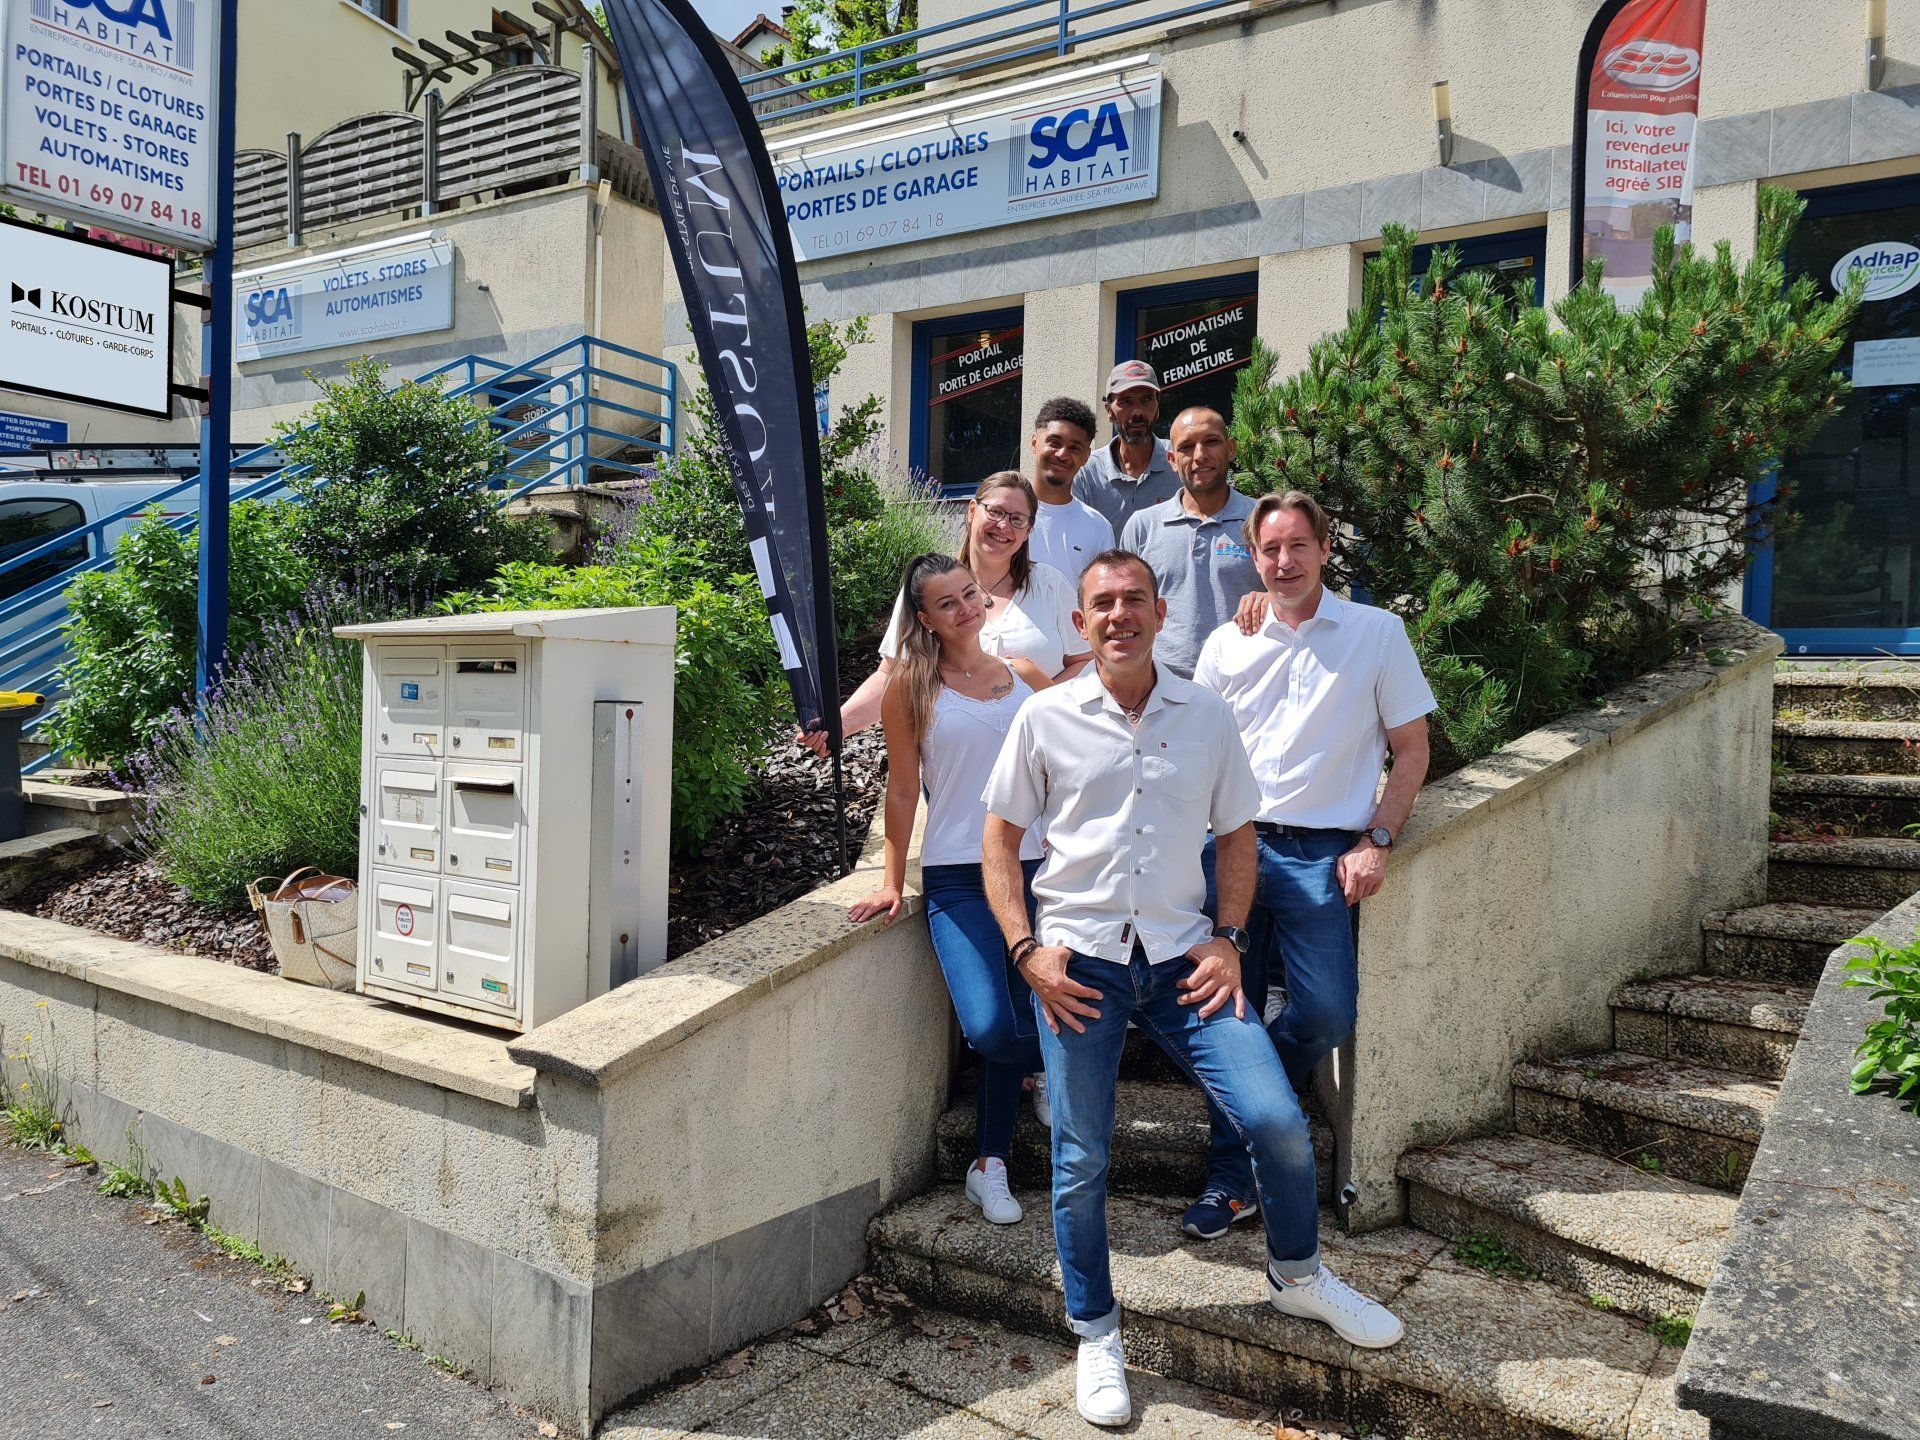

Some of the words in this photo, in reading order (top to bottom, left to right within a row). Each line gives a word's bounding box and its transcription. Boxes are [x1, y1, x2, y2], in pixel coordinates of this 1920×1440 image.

[54, 6, 173, 62] HABITAT
[60, 0, 173, 41] CA
[29, 23, 80, 47] ENTREPRISE
[127, 58, 144, 70] SEA
[16, 43, 102, 87] PORTAILS
[117, 79, 204, 120] CLOTURES
[25, 75, 95, 111] PORTES
[100, 99, 122, 121] DE
[128, 109, 197, 145] GARAGE
[1606, 120, 1628, 135] Ici,
[1634, 124, 1676, 137] votre
[35, 105, 107, 142] VOLETS
[123, 134, 189, 167] STORES
[1028, 102, 1129, 169] SCA
[1606, 140, 1690, 155] revendeur
[39, 136, 184, 192] AUTOMATISMES
[778, 158, 865, 192] PORTAILS
[881, 131, 989, 172] CLOTURES
[1026, 157, 1129, 193] HABITAT
[1606, 156, 1687, 173] installateu
[16, 162, 51, 189] TEL
[58, 174, 79, 196] 01
[90, 184, 114, 205] 69
[120, 192, 144, 212] 07
[150, 200, 173, 222] 84
[181, 208, 202, 230] 18
[786, 192, 856, 222] PORTES
[862, 186, 887, 208] DE
[894, 166, 978, 201] GARAGE
[1007, 201, 1046, 213] ENTREPRISE
[1087, 190, 1101, 199] SEA
[1605, 176, 1650, 192] agréé
[1656, 175, 1683, 190] SIB
[812, 234, 829, 249] TEL
[834, 230, 849, 246] 01
[856, 225, 874, 242] 69
[879, 221, 897, 237] 07
[902, 217, 920, 233] 84
[928, 212, 943, 227] 18
[323, 271, 369, 292] VOLETS
[379, 259, 427, 282] STORES
[1851, 250, 1920, 269] Adhap
[1867, 264, 1902, 276] vices
[51, 290, 154, 335] KOSTUM
[246, 287, 292, 327] SCA
[326, 285, 423, 316] AUTOMATISMES
[11, 319, 47, 335] PORTAILS
[56, 330, 94, 346] CLÔTURES
[102, 340, 154, 359] GARDE-CORPS
[246, 323, 293, 342] HABITAT
[1151, 307, 1244, 351] AUTOMATISME
[1190, 339, 1208, 356] DE
[959, 343, 1002, 367] PORTAIL
[1163, 348, 1234, 384] FERMETURE
[939, 375, 967, 394] PORTE
[969, 370, 981, 384] DE
[984, 355, 1023, 378] GARAGE
[6, 425, 37, 434] PORTAILS
[740, 481, 755, 509] DES
